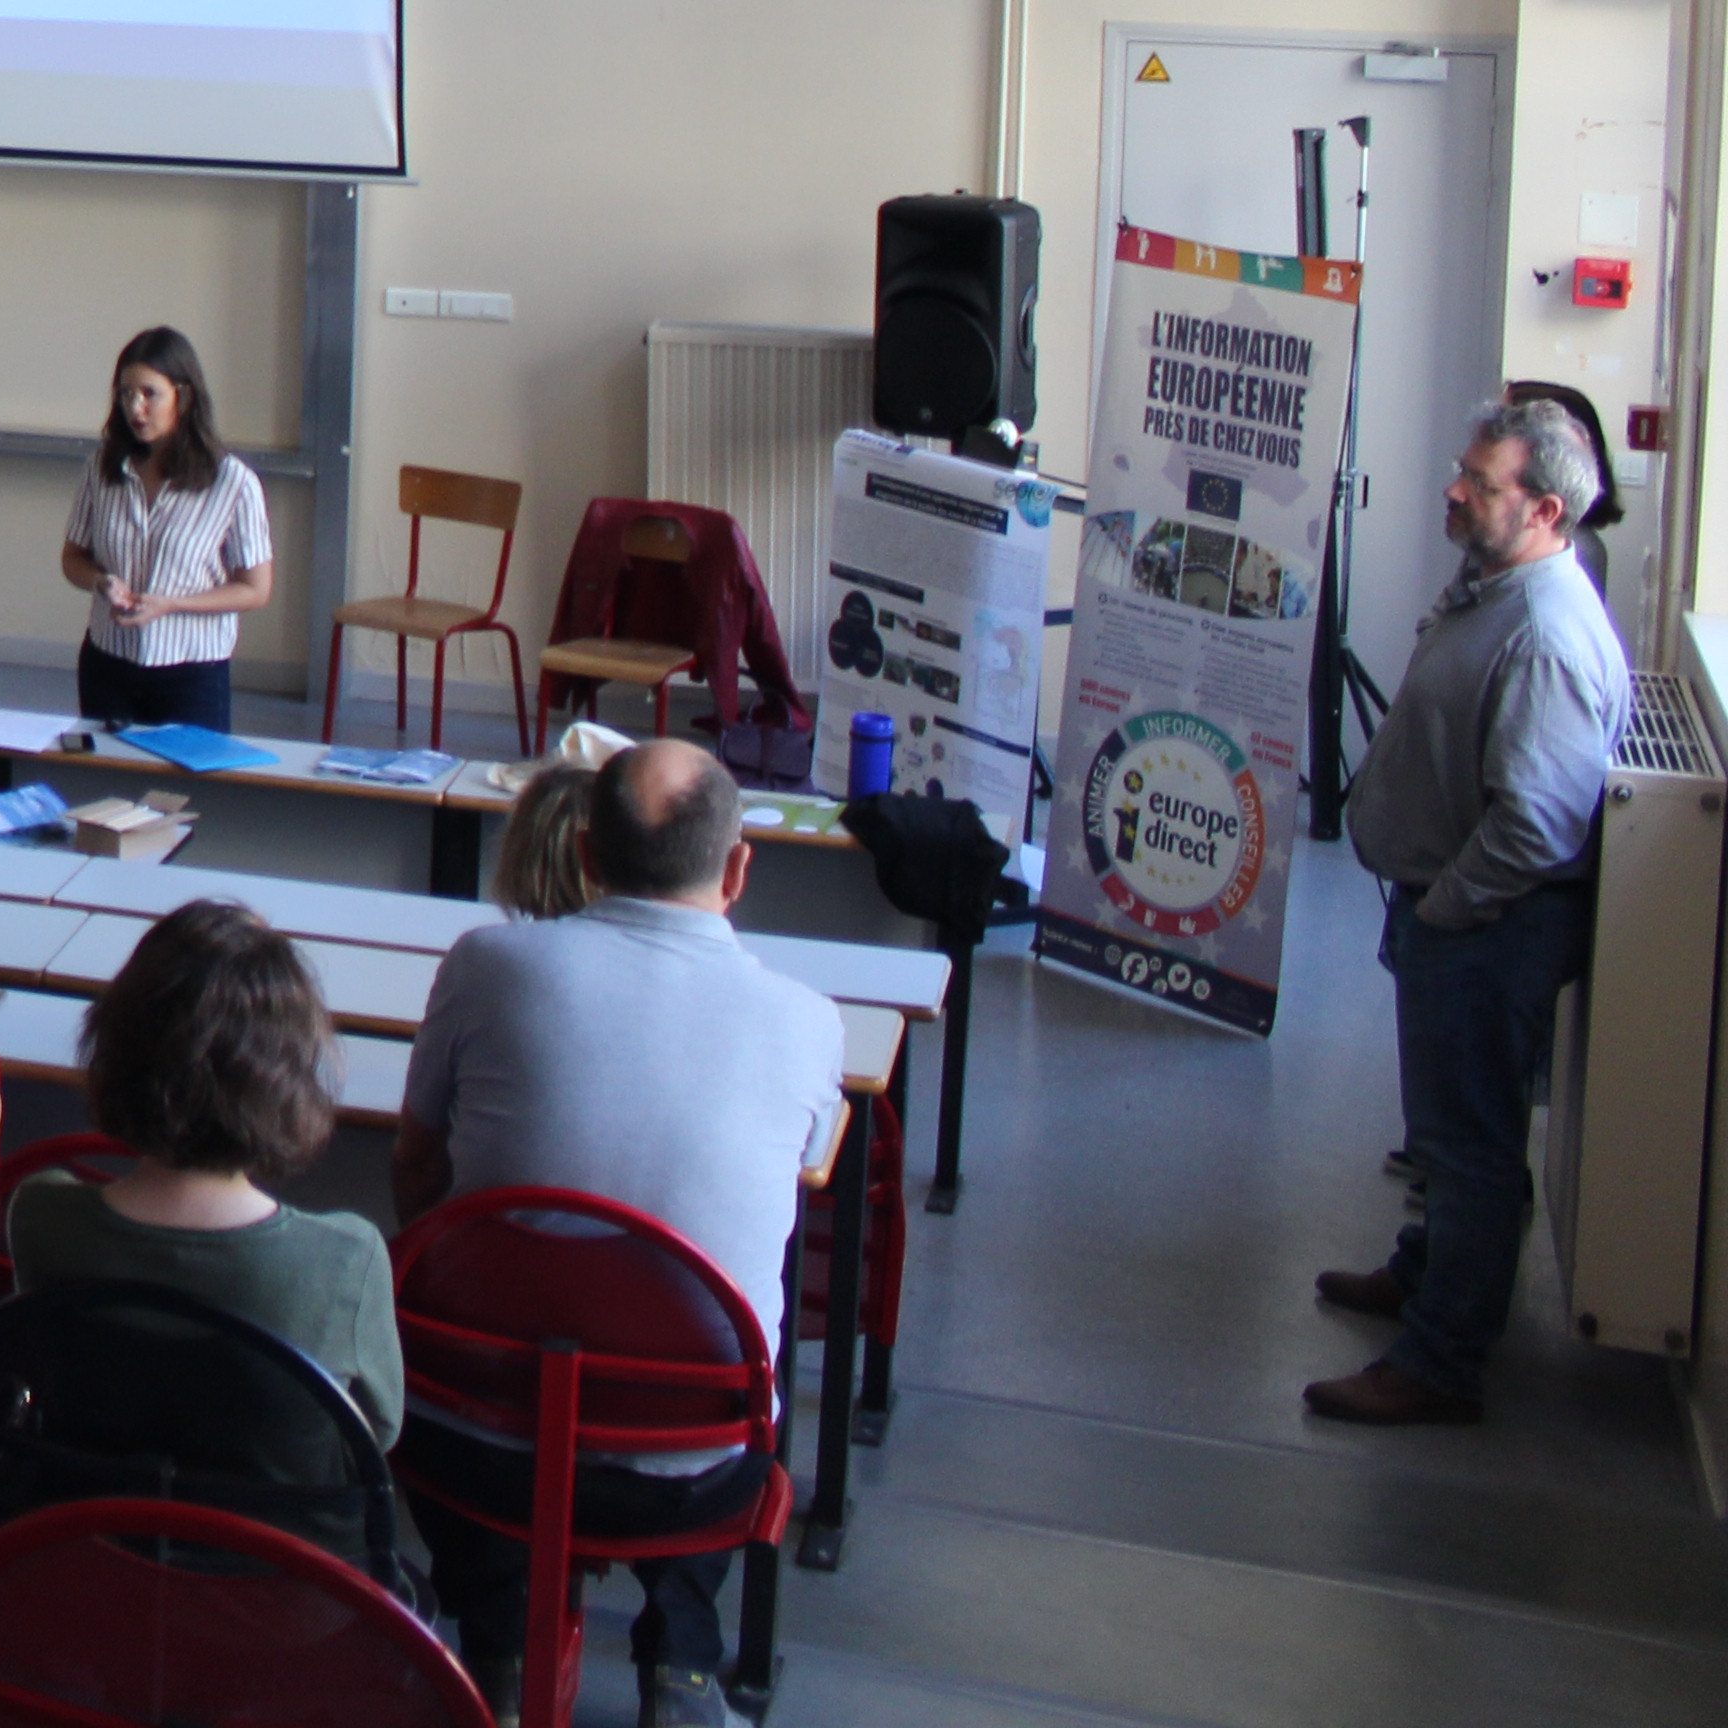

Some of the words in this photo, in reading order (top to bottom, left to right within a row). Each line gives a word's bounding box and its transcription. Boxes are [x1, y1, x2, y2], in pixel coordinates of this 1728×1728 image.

[1151, 309, 1313, 377] L'INFORMATION
[1147, 355, 1307, 432] EUROPÉENNE
[1143, 403, 1184, 443] PRÈS
[1188, 415, 1210, 447] DE
[1213, 420, 1257, 457] CHEZ
[1255, 429, 1303, 470] VOUS
[1142, 717, 1233, 762] INFORMER
[1086, 755, 1117, 839] ANIMER
[1148, 791, 1238, 841] europe
[1144, 819, 1219, 869] direct
[1223, 784, 1259, 910] CONSEILLER
